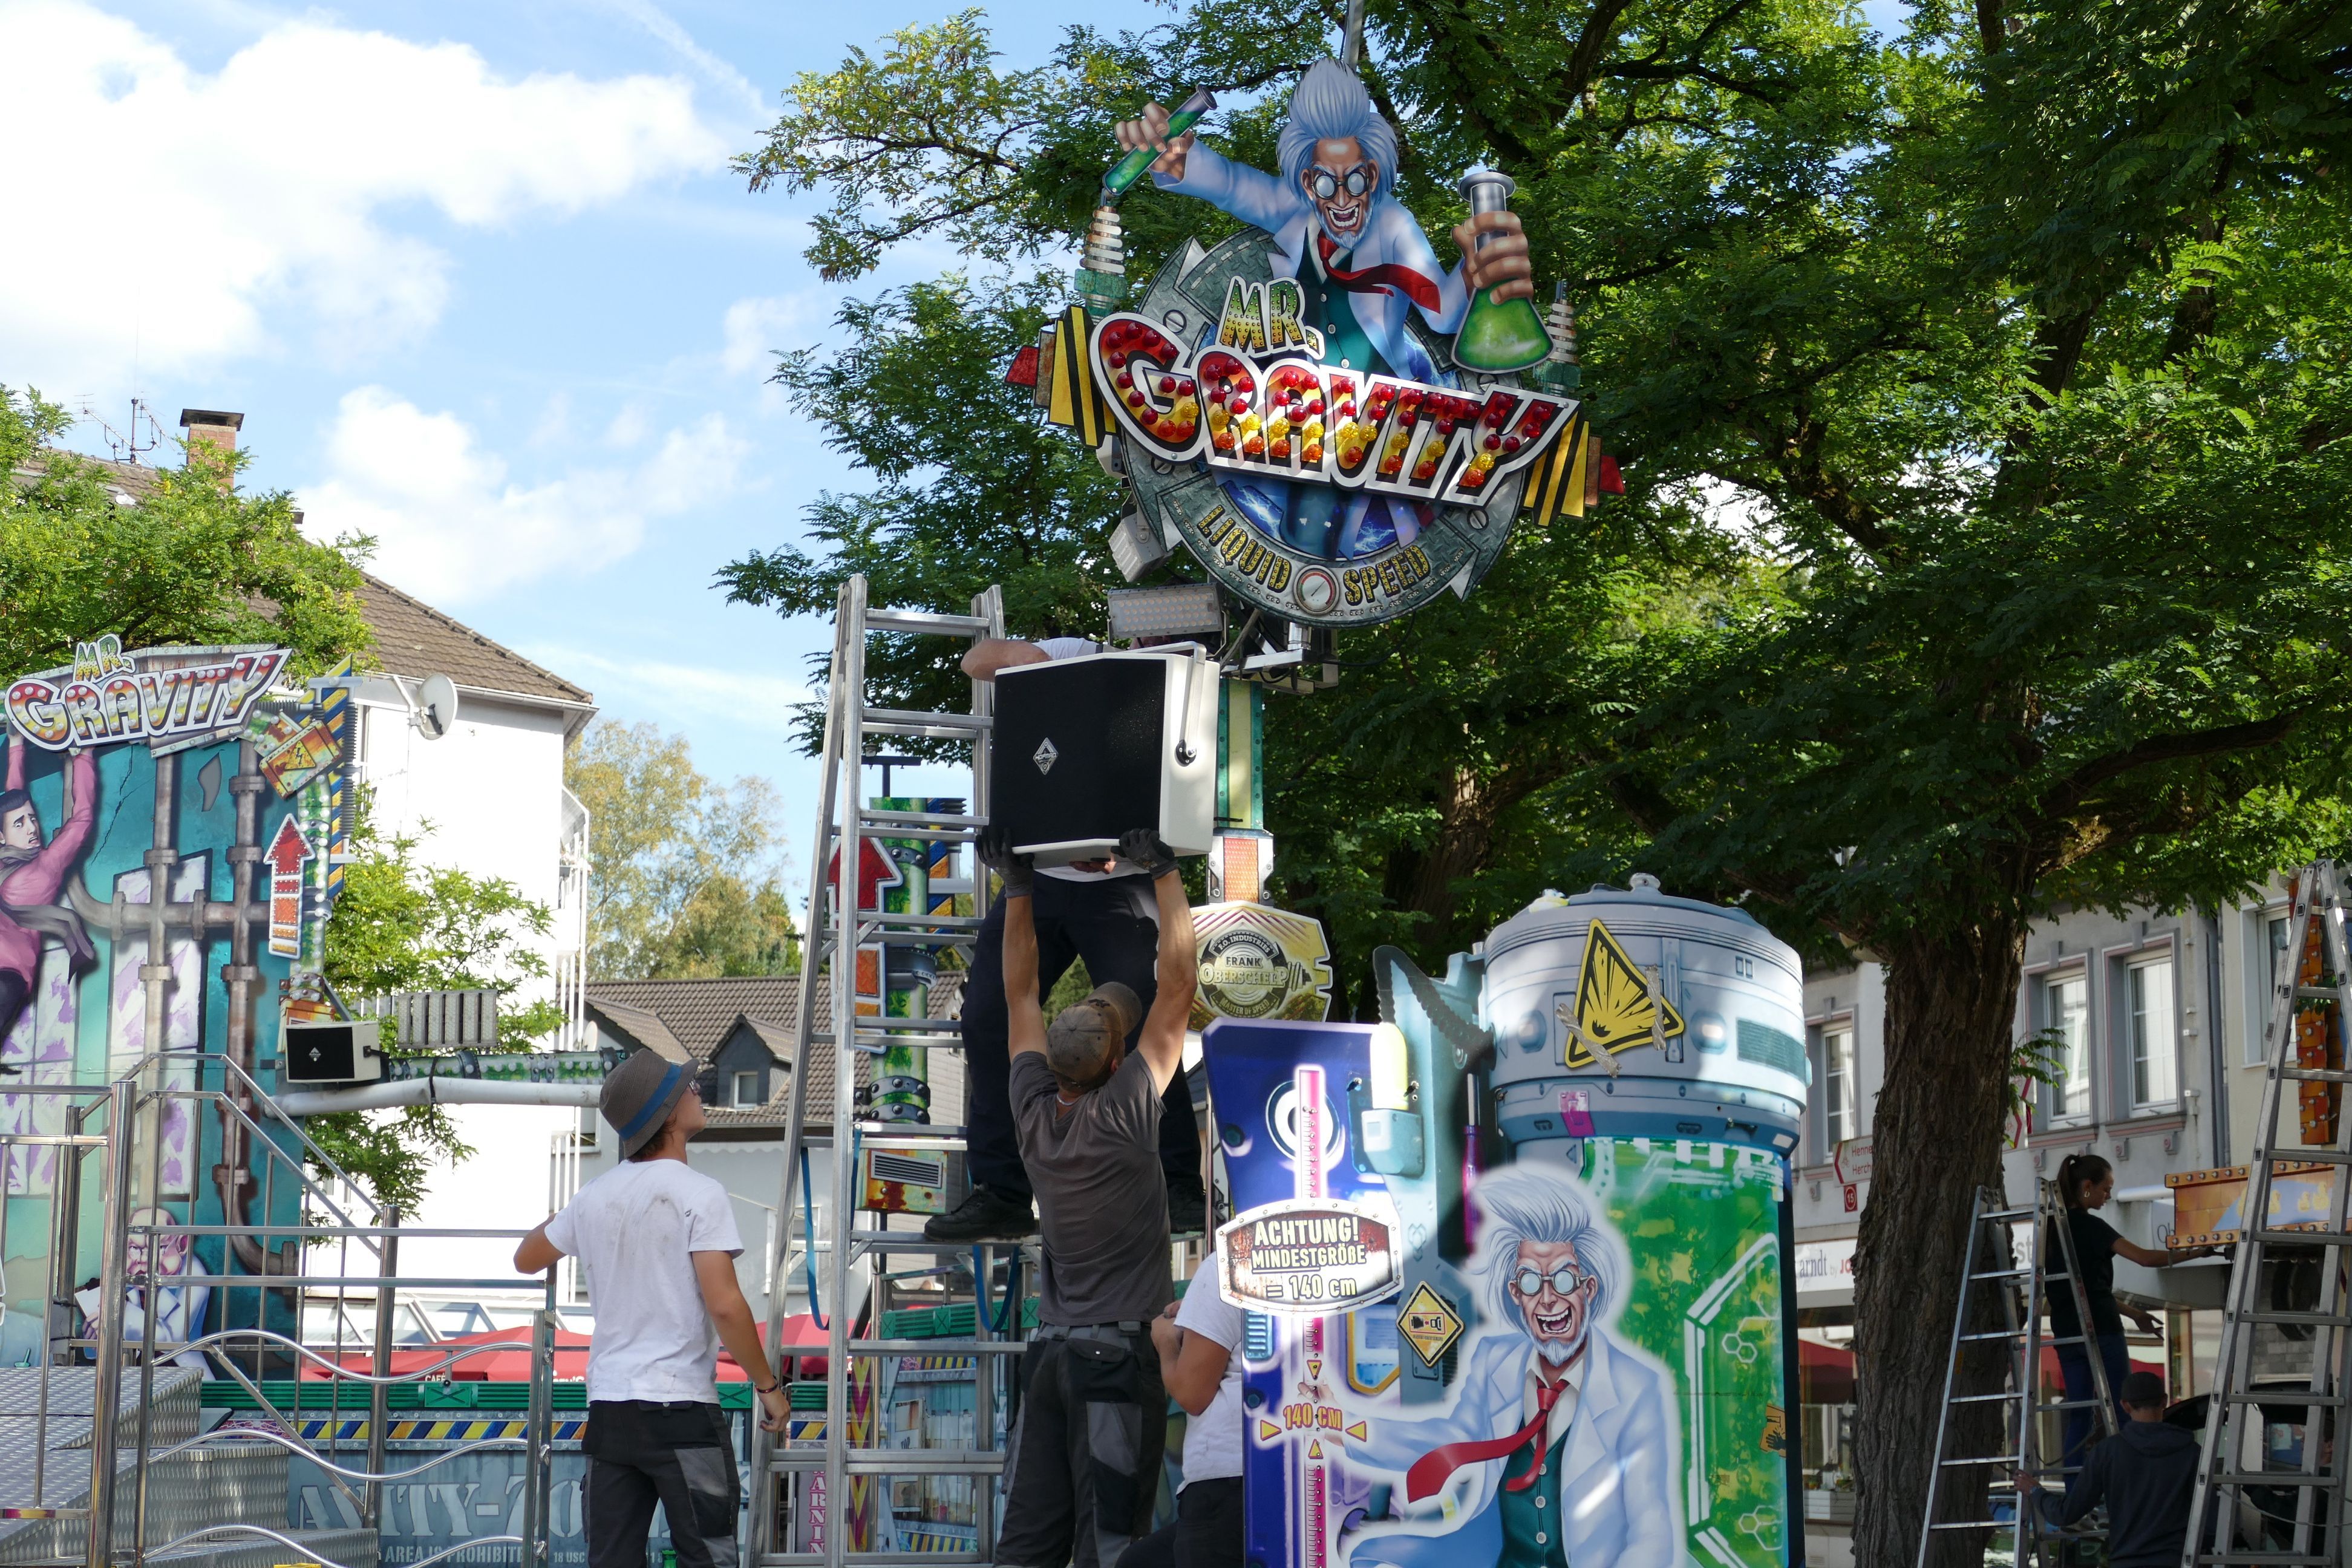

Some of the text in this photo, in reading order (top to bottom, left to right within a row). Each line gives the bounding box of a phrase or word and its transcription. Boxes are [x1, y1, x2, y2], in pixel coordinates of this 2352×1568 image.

[1218, 278, 1321, 354] MR.
[1093, 315, 1576, 503] GRAVITY
[1197, 505, 1431, 606] LIQUID SPEED
[74, 633, 134, 682] MR.
[5, 649, 291, 749] GRAVITY
[1230, 935, 1270, 953] INDUSTRIES
[1226, 956, 1263, 967] FRANK
[1220, 999, 1244, 1014] MASTER
[1252, 999, 1270, 1014] SPEED
[1847, 1194, 1854, 1203] 15
[1254, 1217, 1359, 1246] ACHTUNG!
[1289, 1274, 1323, 1299] 140
[1328, 1278, 1357, 1298] cm
[1283, 1402, 1342, 1432] 140 CM
[809, 1471, 826, 1553] ARNIN
[385, 1546, 423, 1563] AREA
[553, 1552, 563, 1563] 18
[566, 1552, 586, 1563] USC
